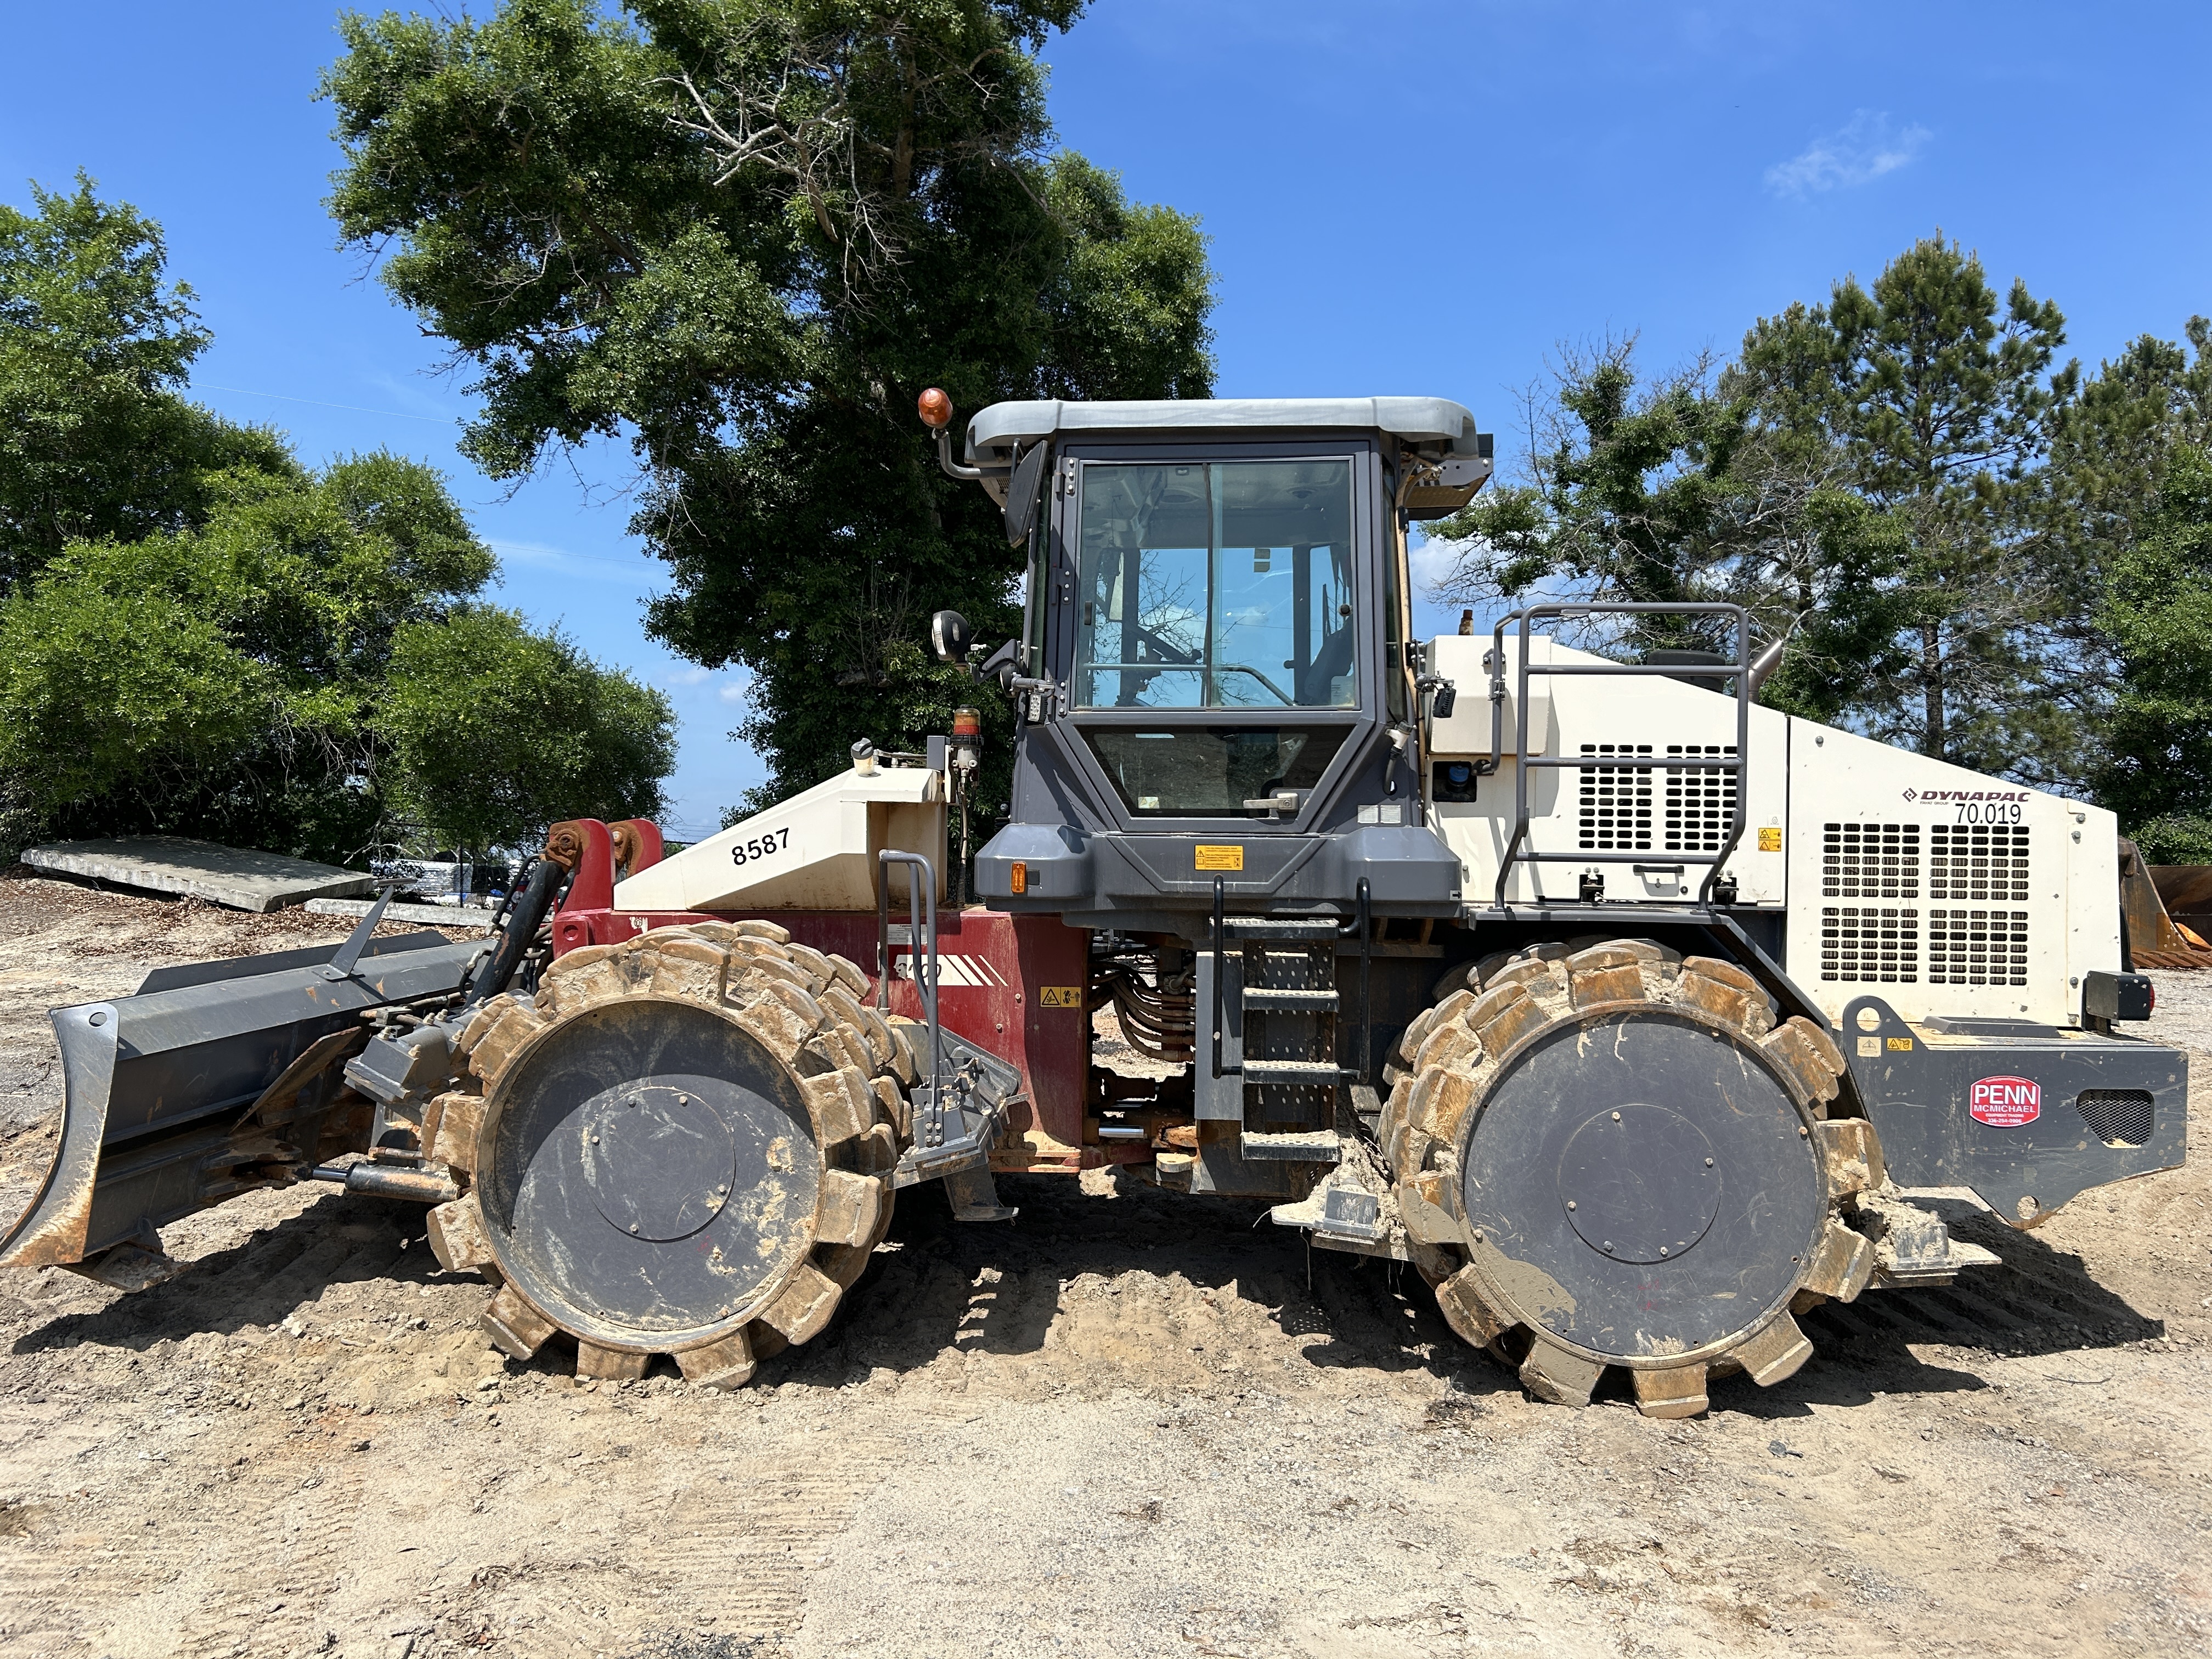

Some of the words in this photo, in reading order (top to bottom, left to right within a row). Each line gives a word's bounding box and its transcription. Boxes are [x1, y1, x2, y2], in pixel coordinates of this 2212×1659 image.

[1920, 791, 2031, 802] DYNAPAC
[1954, 803, 2021, 825] 70.019
[731, 827, 789, 866] 8587
[1974, 1084, 2036, 1105] PENN
[1973, 1104, 2036, 1113] MCMICHAEL
